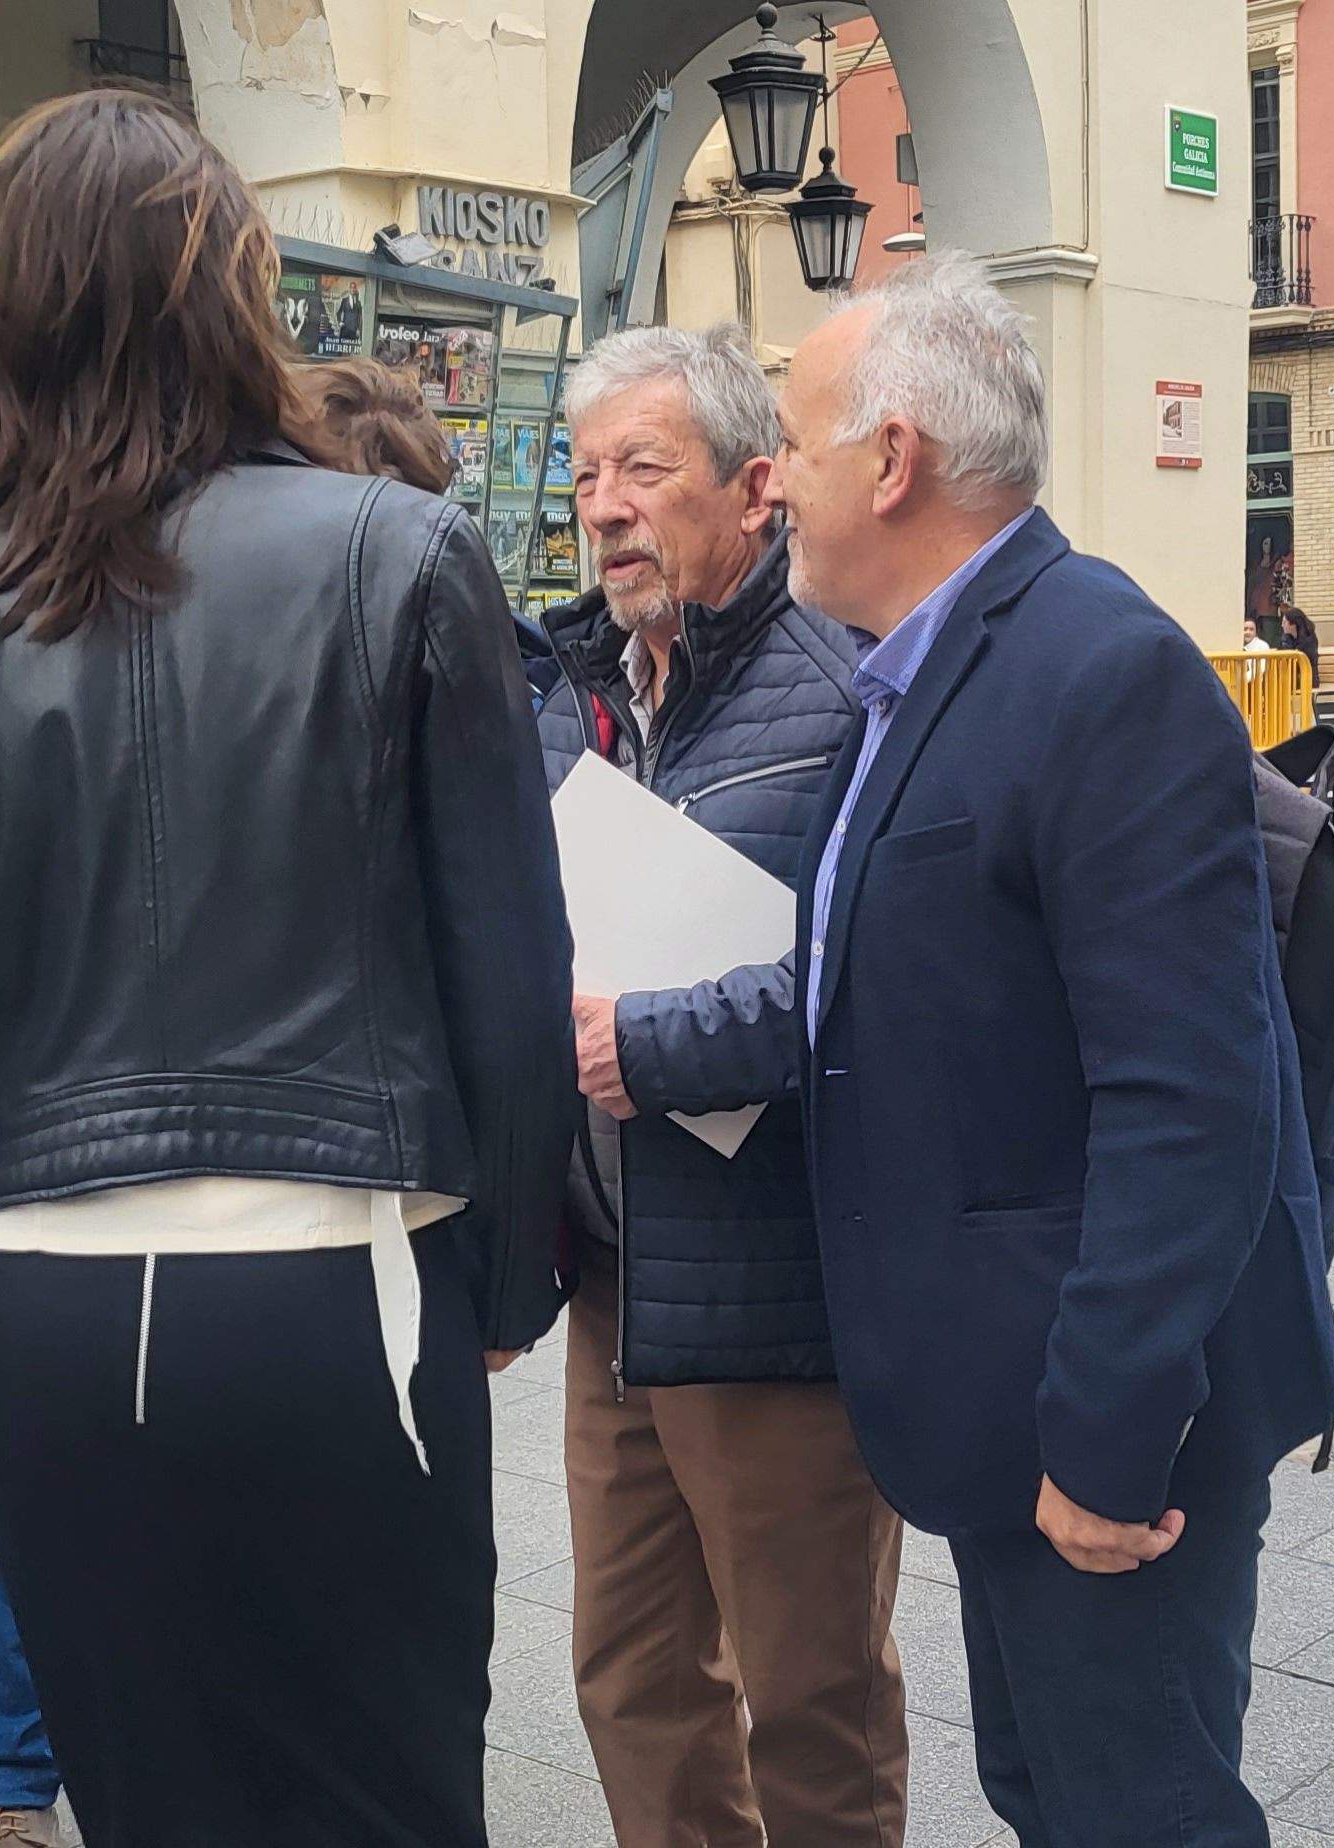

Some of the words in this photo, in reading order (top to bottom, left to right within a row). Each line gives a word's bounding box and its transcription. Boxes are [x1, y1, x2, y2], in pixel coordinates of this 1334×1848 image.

[1182, 132, 1210, 149] PORCHES
[1184, 148, 1209, 164] GALICIA
[417, 186, 550, 248] KIOSKO
[378, 324, 420, 341] trofeo
[423, 331, 440, 343] Jara
[546, 510, 573, 523] muy
